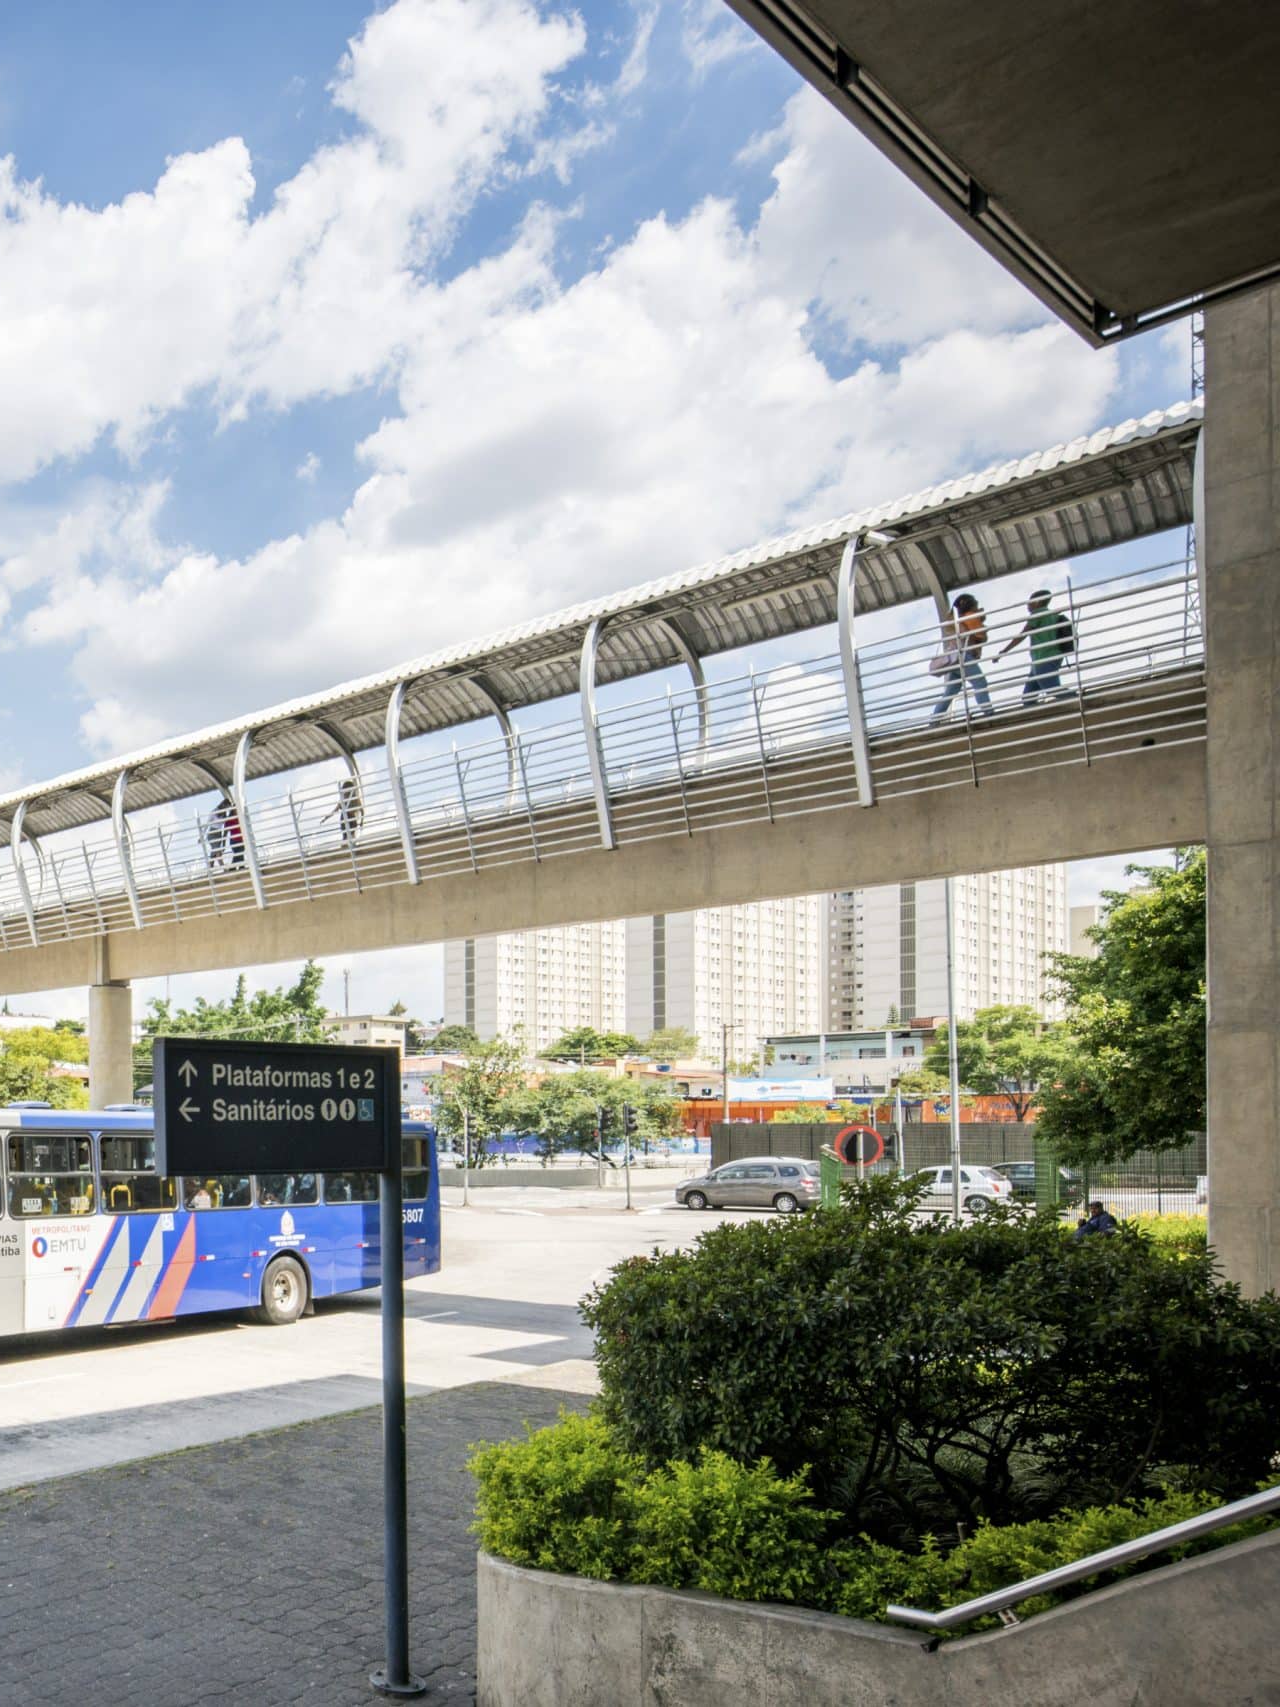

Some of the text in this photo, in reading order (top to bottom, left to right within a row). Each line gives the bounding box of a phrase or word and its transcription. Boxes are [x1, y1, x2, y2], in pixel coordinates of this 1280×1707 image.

[212, 1063, 375, 1089] Plataformas 1 e 2
[212, 1098, 315, 1121] Sanitários
[402, 1208, 424, 1223] 5807
[51, 1237, 86, 1253] EMTU
